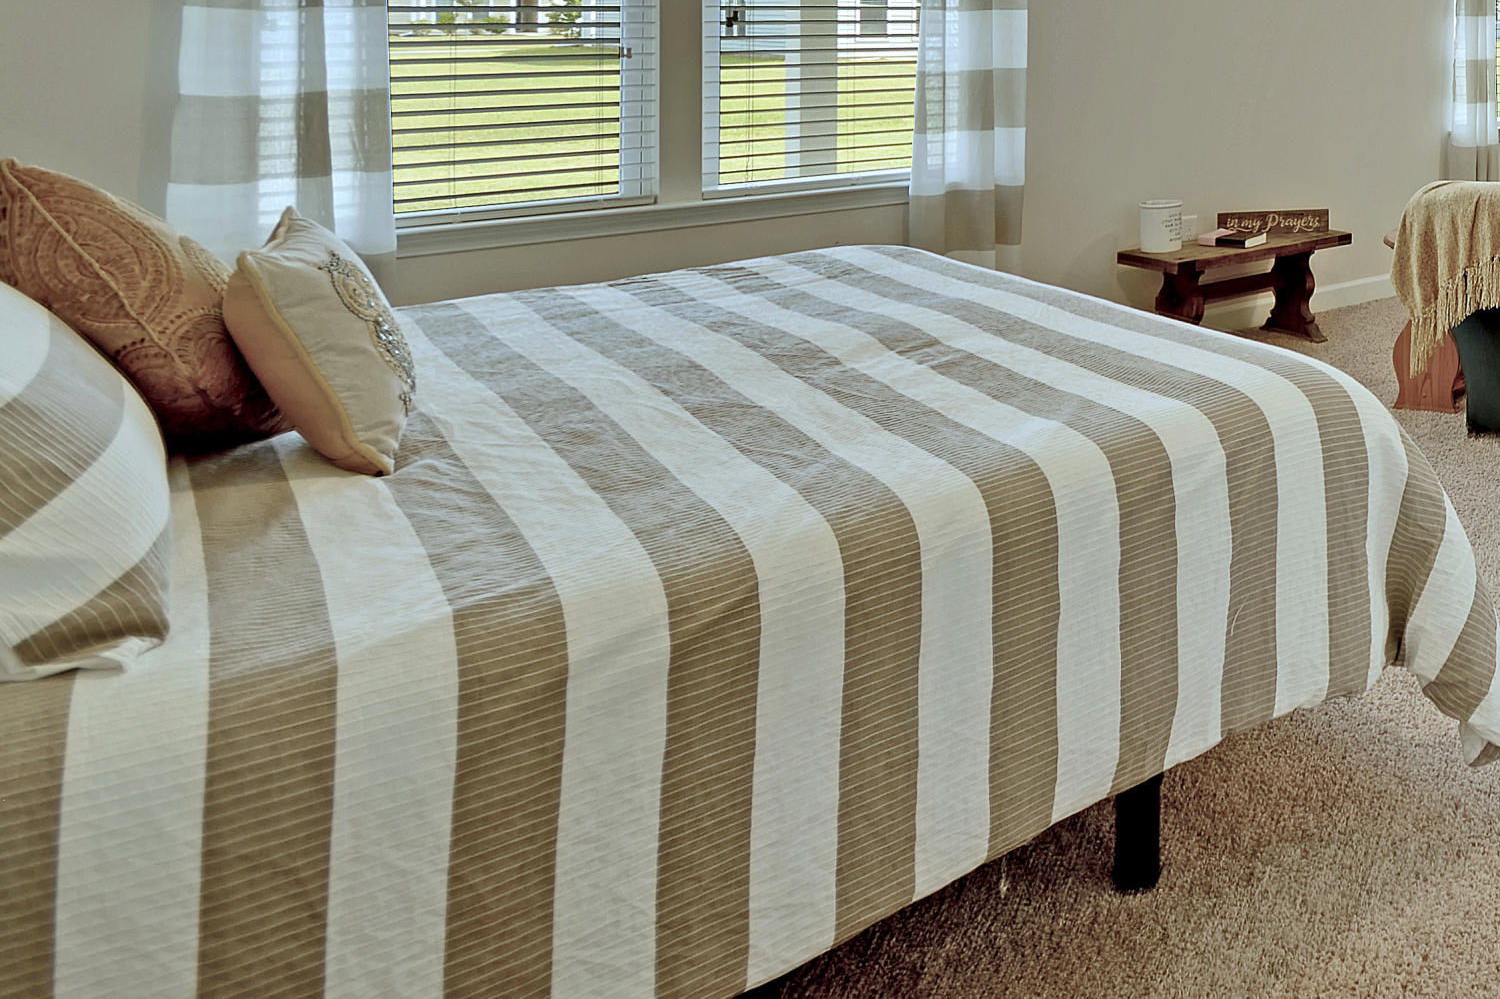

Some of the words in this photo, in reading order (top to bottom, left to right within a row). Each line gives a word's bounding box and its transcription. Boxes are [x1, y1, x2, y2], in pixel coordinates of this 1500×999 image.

[1226, 217, 1240, 229] in
[1241, 218, 1263, 233] my
[1262, 213, 1319, 233] Prayers
